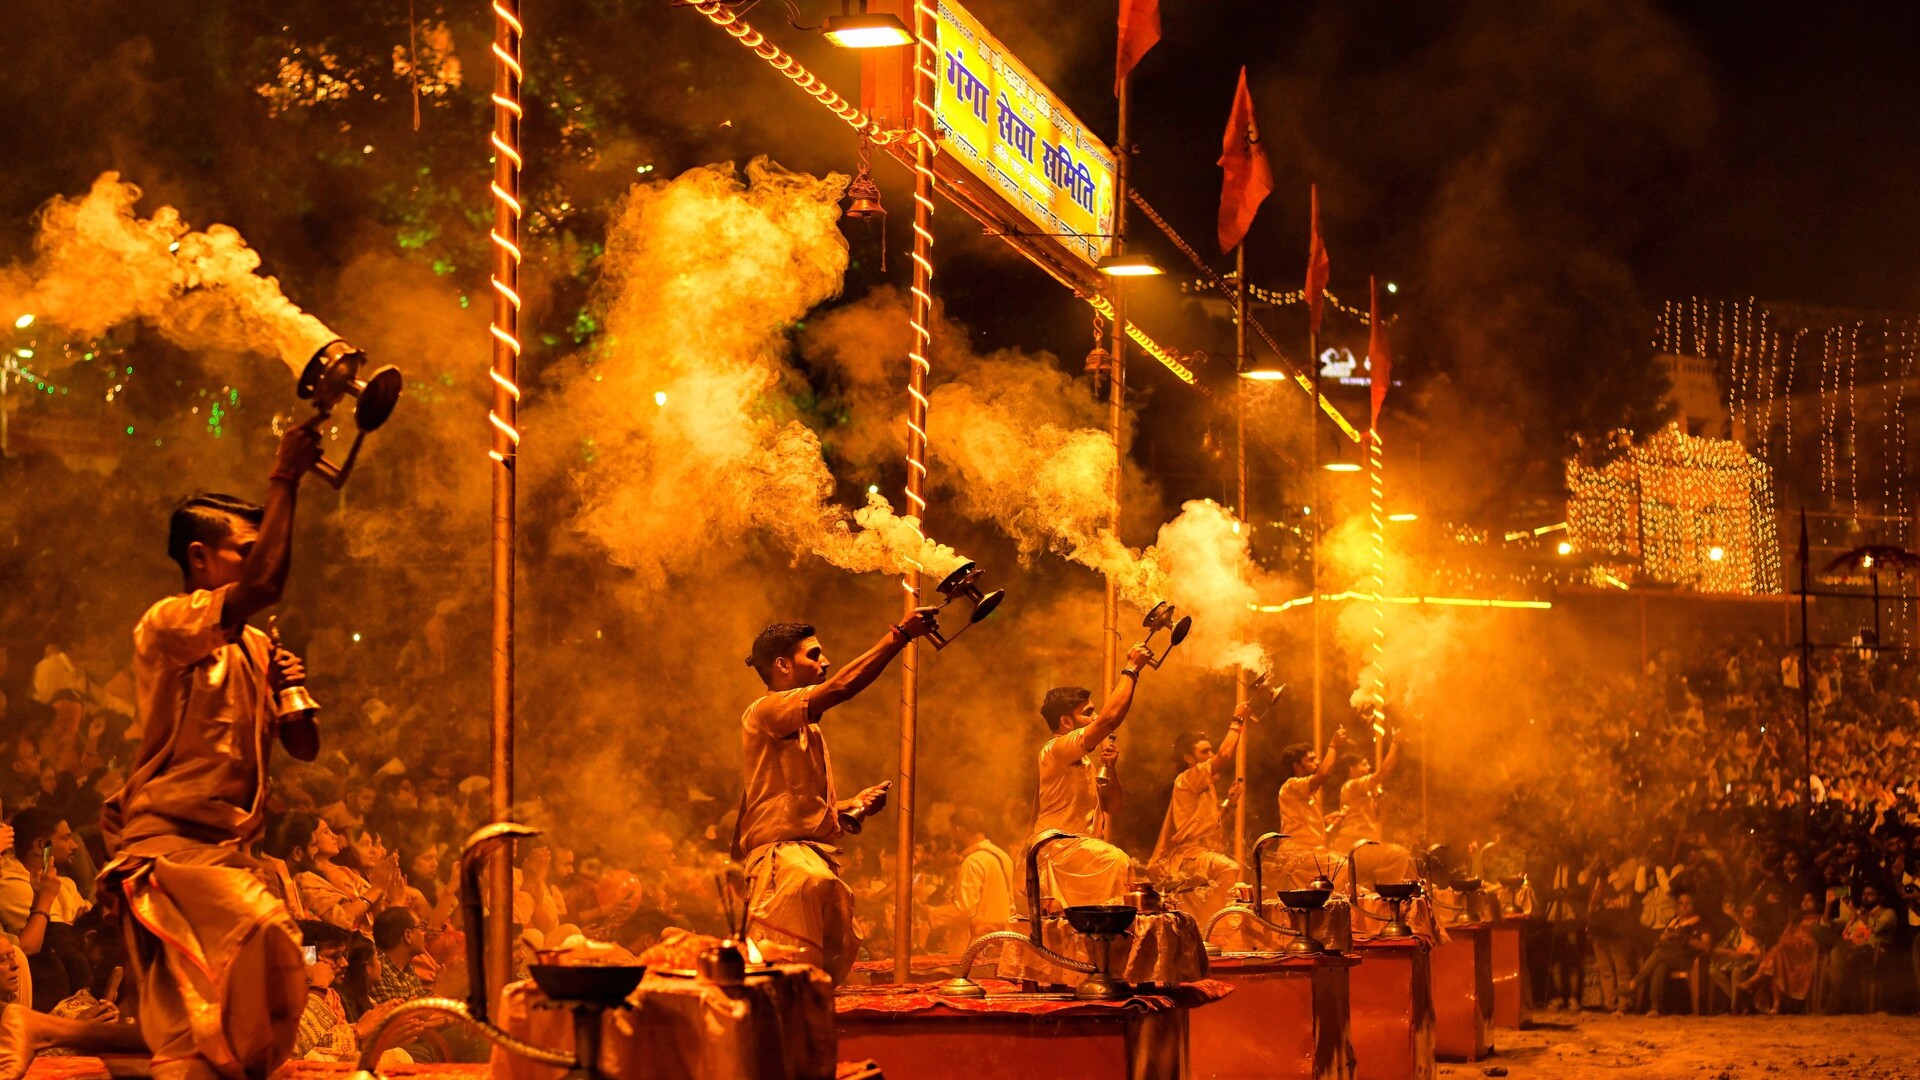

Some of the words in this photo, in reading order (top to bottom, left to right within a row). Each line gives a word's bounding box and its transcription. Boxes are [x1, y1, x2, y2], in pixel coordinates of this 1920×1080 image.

[945, 50, 989, 124] गंगा
[997, 92, 1035, 164] सेवा
[1042, 140, 1094, 214] समिति
